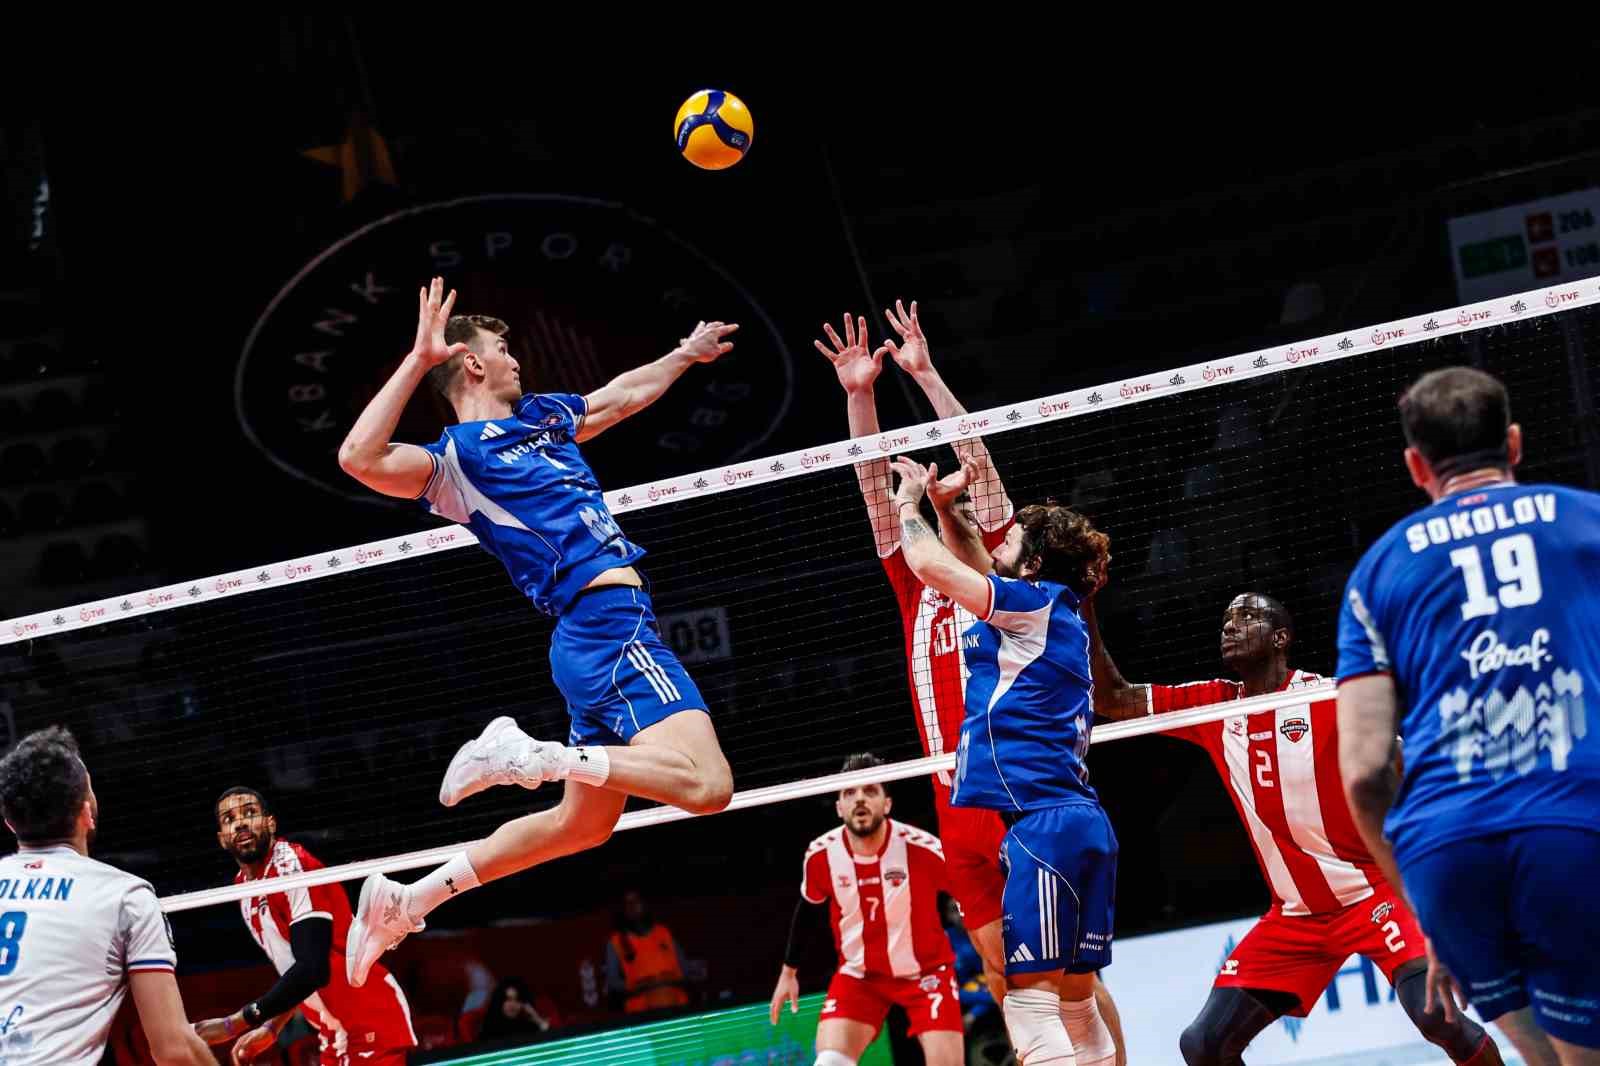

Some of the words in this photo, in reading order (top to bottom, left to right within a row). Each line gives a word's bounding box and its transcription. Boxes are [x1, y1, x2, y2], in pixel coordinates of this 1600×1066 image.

[659, 486, 678, 496] TVF
[735, 470, 754, 480] TVF
[814, 453, 831, 463] TVF
[892, 436, 909, 447] TVF
[970, 419, 989, 429] TVF
[1052, 401, 1070, 412] TVF
[1133, 384, 1152, 393] TVF
[1215, 366, 1234, 377] TVF
[1300, 347, 1319, 358] TVF
[1384, 328, 1404, 341] TVF
[1471, 311, 1489, 321] TVF
[1560, 291, 1579, 302] TVF
[1405, 493, 1557, 554] SOKOLOV
[295, 565, 312, 577] TVF
[365, 549, 383, 559] TVF
[438, 533, 456, 543] TVF
[1449, 533, 1543, 622] 19
[1255, 749, 1275, 788] 2
[865, 896, 880, 922] 7
[1380, 919, 1406, 953] 2
[927, 992, 944, 1020] 7
